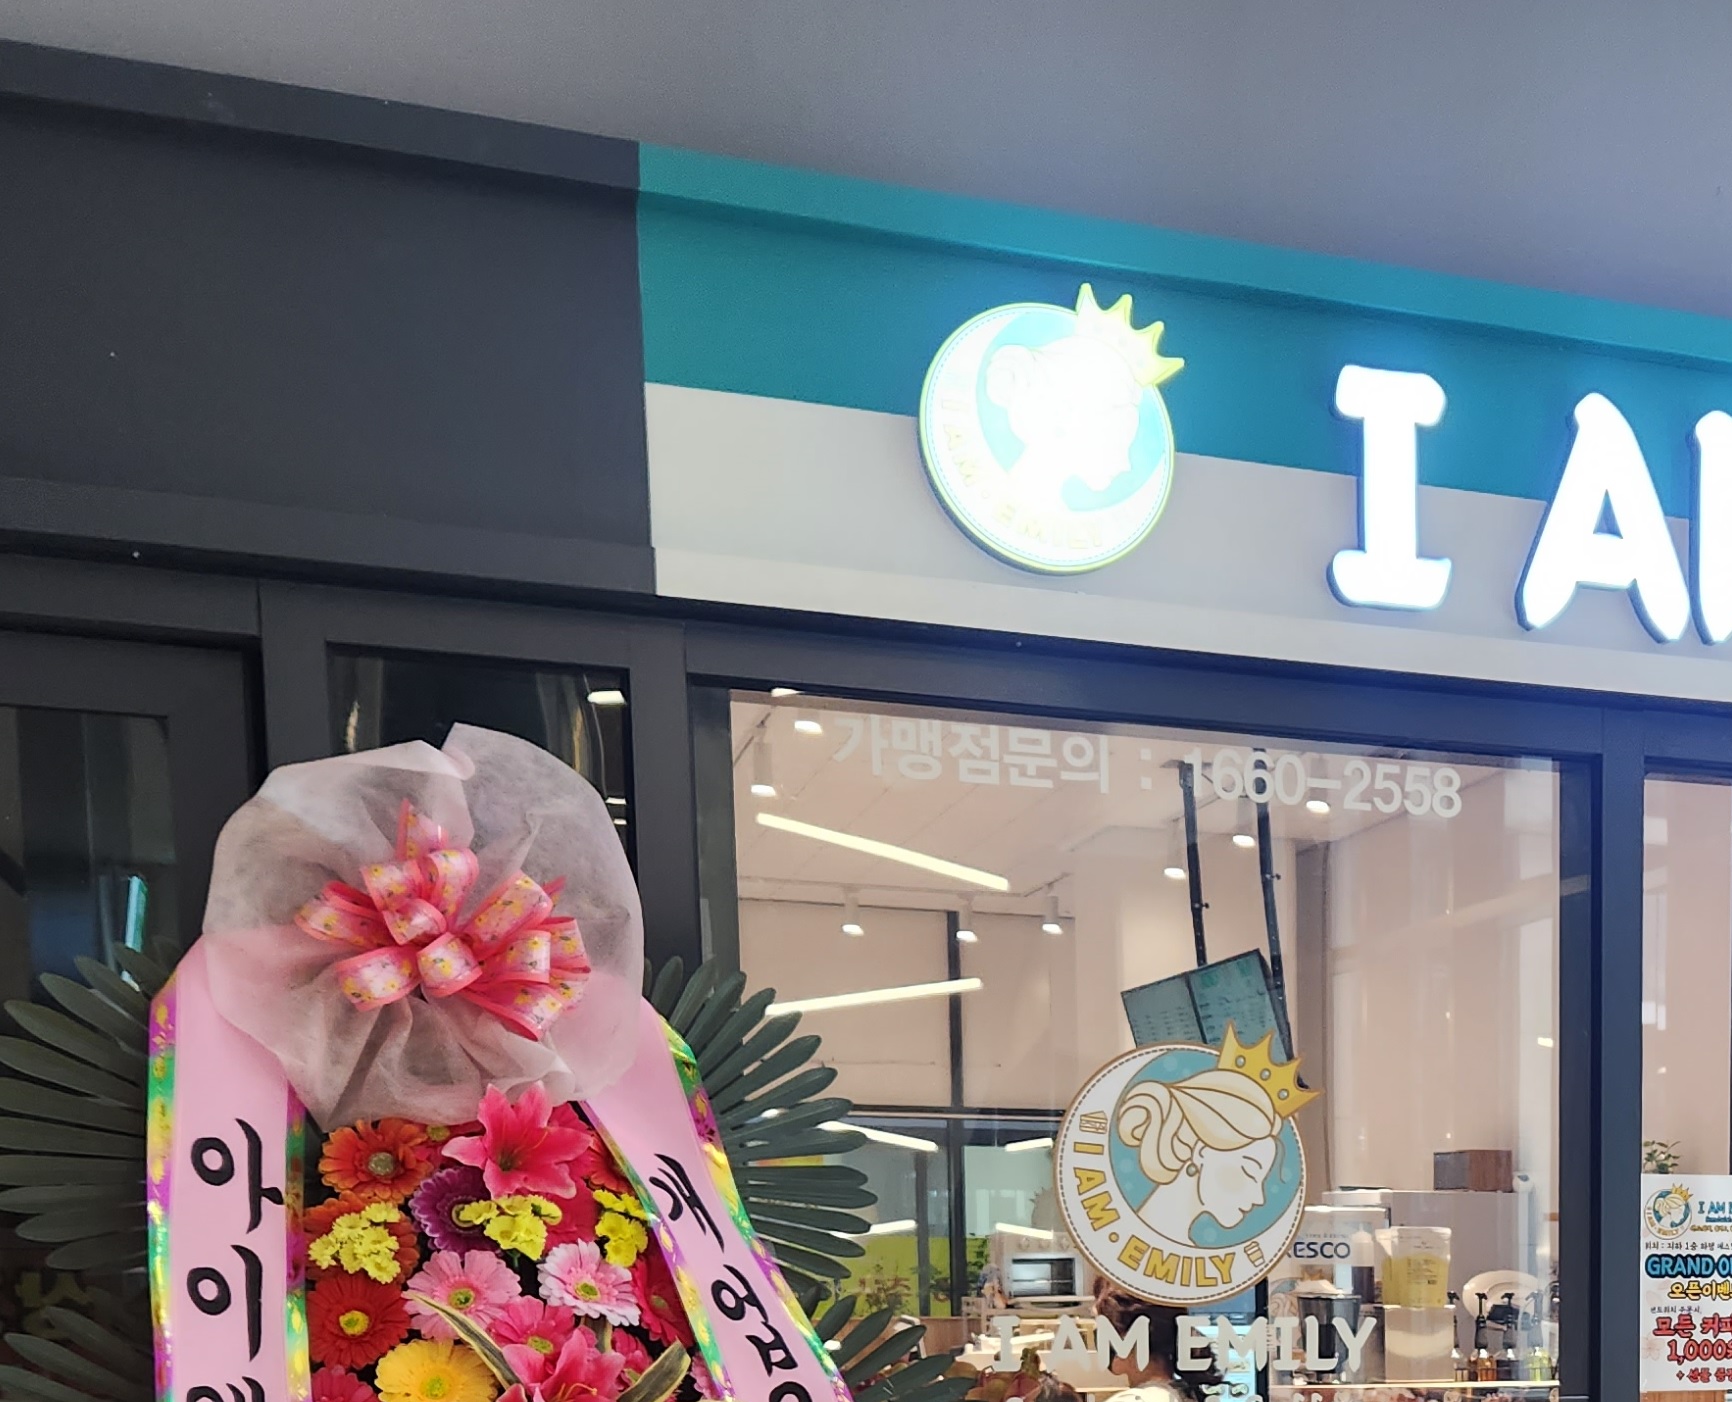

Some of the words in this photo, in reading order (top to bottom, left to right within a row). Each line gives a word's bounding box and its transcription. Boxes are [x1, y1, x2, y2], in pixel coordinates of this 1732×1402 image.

[1326, 364, 1452, 610] I
[833, 715, 1110, 793] 가맹점문의
[1188, 748, 1463, 820] 1660-2558
[1073, 1141, 1104, 1155] I
[1073, 1166, 1121, 1231] AM
[1708, 1201, 1726, 1214] AM
[1117, 1234, 1236, 1288] EMILY
[1645, 1254, 1716, 1278] GRAND
[991, 1315, 1021, 1372] I
[1046, 1314, 1151, 1373] AM
[1176, 1314, 1378, 1373] EMILY
[1652, 1313, 1696, 1338] 모든
